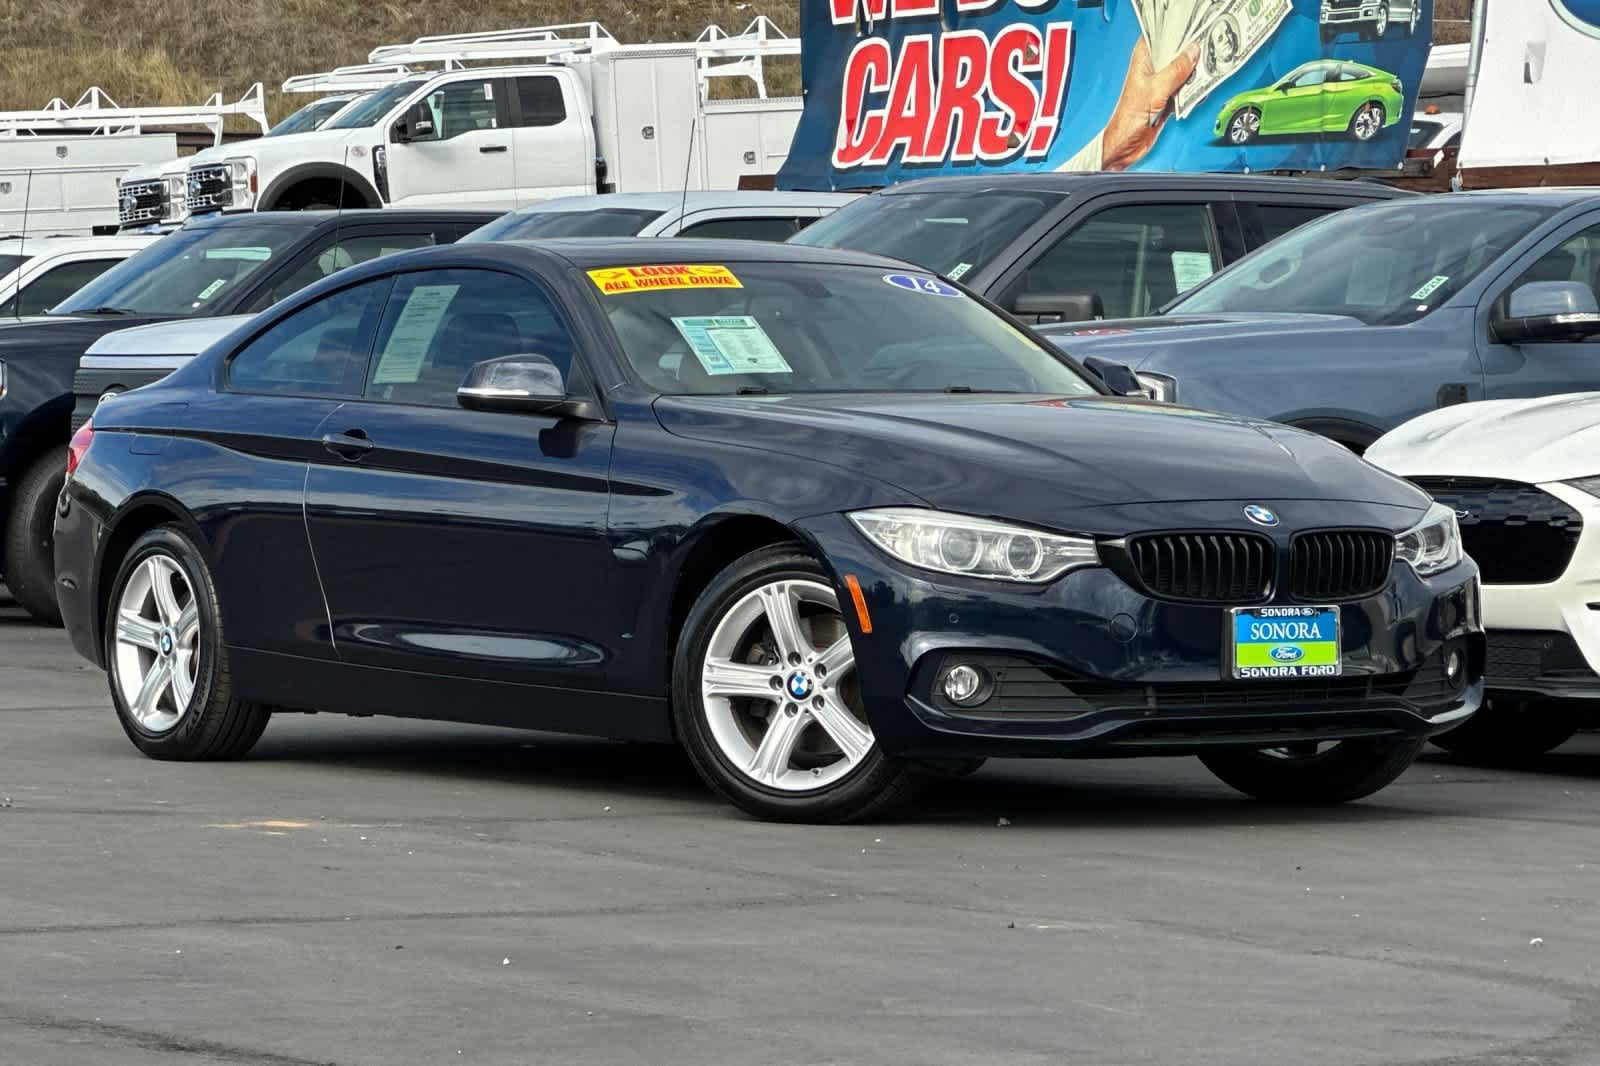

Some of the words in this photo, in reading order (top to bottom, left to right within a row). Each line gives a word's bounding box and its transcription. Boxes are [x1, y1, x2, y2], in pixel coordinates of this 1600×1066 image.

[832, 21, 1073, 168] CARS!
[628, 265, 692, 277] LOOK
[605, 280, 632, 292] ALL
[635, 276, 687, 289] WHEEL
[690, 275, 734, 286] DRIVE
[1260, 607, 1300, 617] SONORA
[1250, 622, 1322, 640] SONORA
[1275, 648, 1298, 659] Ford
[1241, 667, 1297, 677] SONORA
[1301, 666, 1335, 675] FORD
